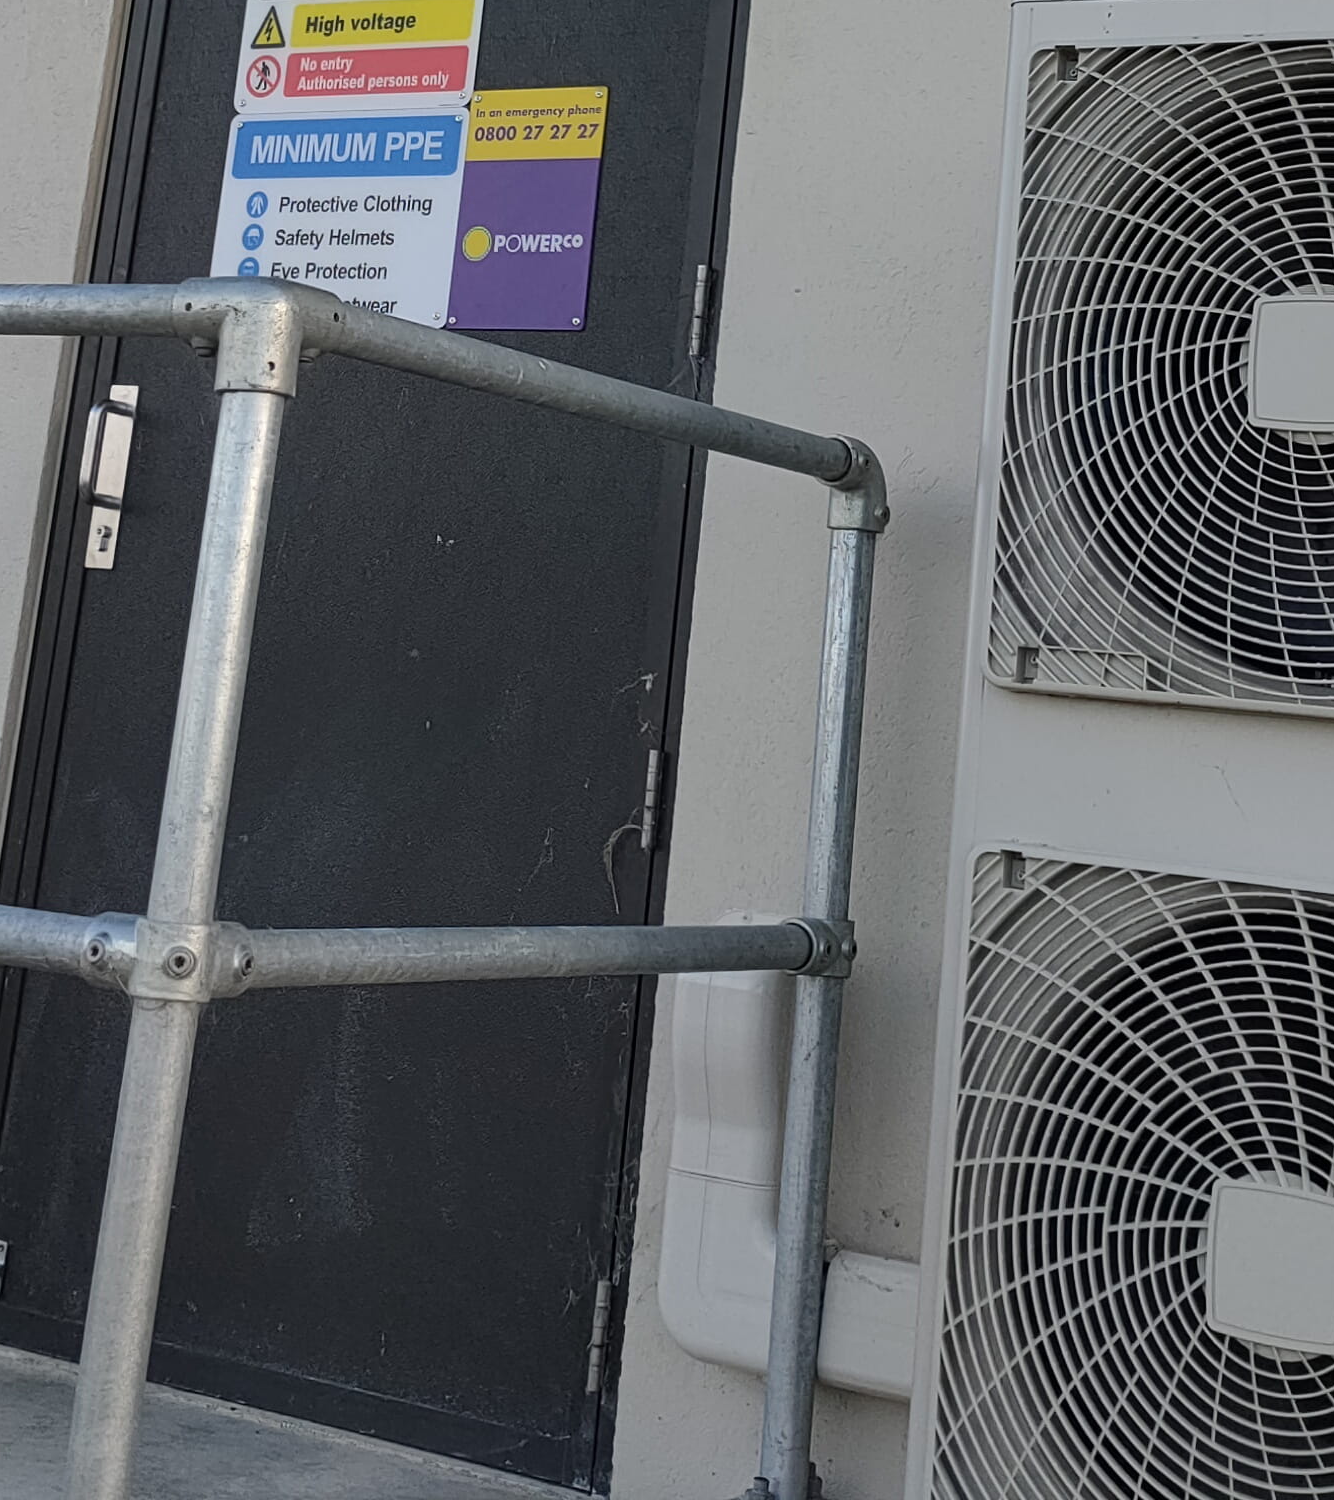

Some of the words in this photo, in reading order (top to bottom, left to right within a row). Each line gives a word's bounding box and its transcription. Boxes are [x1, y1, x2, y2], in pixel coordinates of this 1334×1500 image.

[305, 14, 345, 37] High
[351, 12, 417, 34] voltage
[299, 57, 317, 71] No
[320, 56, 353, 75] entry
[297, 73, 365, 92] Authorised
[368, 73, 418, 92] persons
[422, 71, 450, 88] only
[476, 108, 487, 119] In
[489, 109, 503, 119] an
[505, 107, 565, 119] emergency
[567, 103, 602, 119] phone
[475, 126, 517, 141] 0800
[523, 125, 545, 141] 27
[550, 124, 573, 140] 27
[577, 123, 600, 139] 27
[250, 132, 378, 164] MINIMUM
[384, 130, 445, 161] PPE
[279, 195, 359, 213] Protective
[363, 194, 433, 215] Clothing
[275, 229, 324, 250] Safety
[329, 228, 395, 246] Helmets
[493, 234, 584, 254] POWERCO
[271, 262, 300, 280] Eye
[304, 262, 388, 280] Protection
[342, 297, 398, 314] twear
